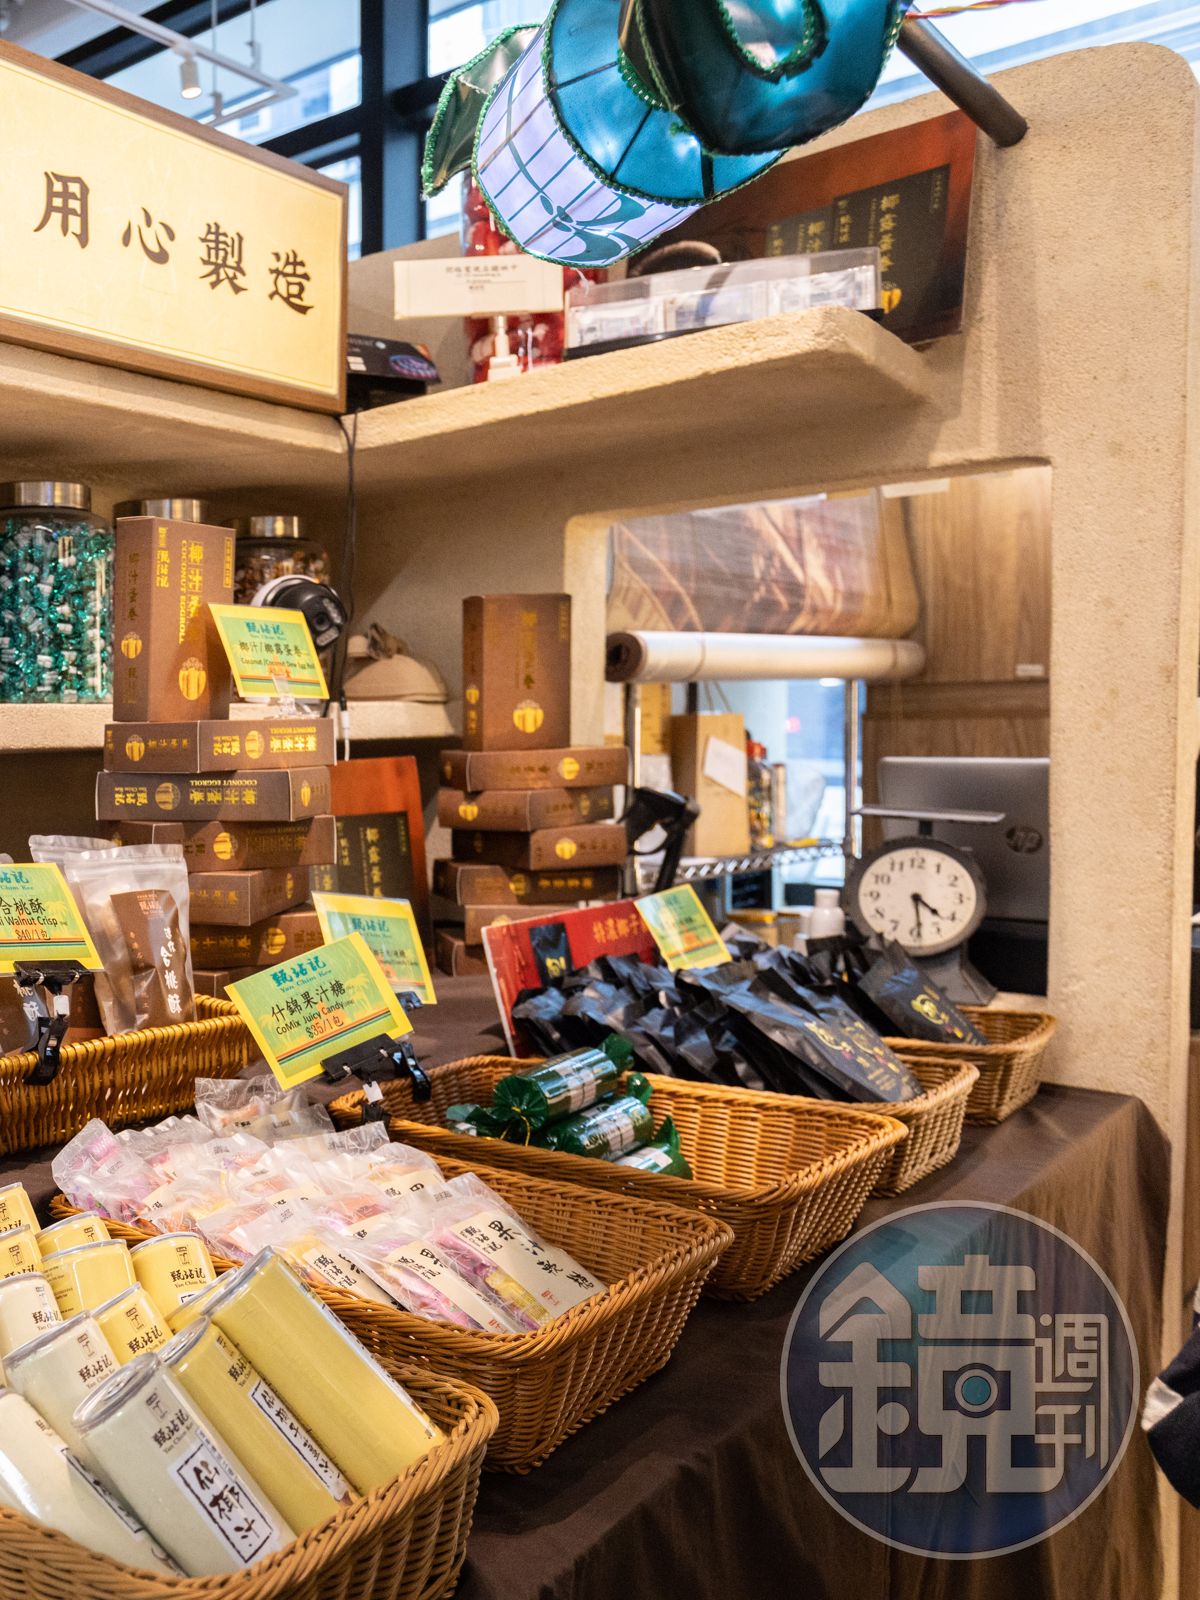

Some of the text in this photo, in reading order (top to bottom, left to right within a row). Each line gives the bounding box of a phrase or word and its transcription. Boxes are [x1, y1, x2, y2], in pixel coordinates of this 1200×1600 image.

[889, 861, 905, 872] 11
[909, 857, 926, 869] 12
[935, 863, 942, 874] 1
[874, 874, 892, 885] 10
[948, 875, 959, 888] 2
[869, 890, 880, 901] 9
[957, 893, 964, 905] 3
[6, 915, 36, 927] Walnut
[37, 915, 58, 928] Crisp
[889, 920, 900, 932] 7
[271, 979, 346, 1022] 什錦果汁糖
[302, 1011, 322, 1024] Juicy
[321, 1000, 345, 1016] Candy
